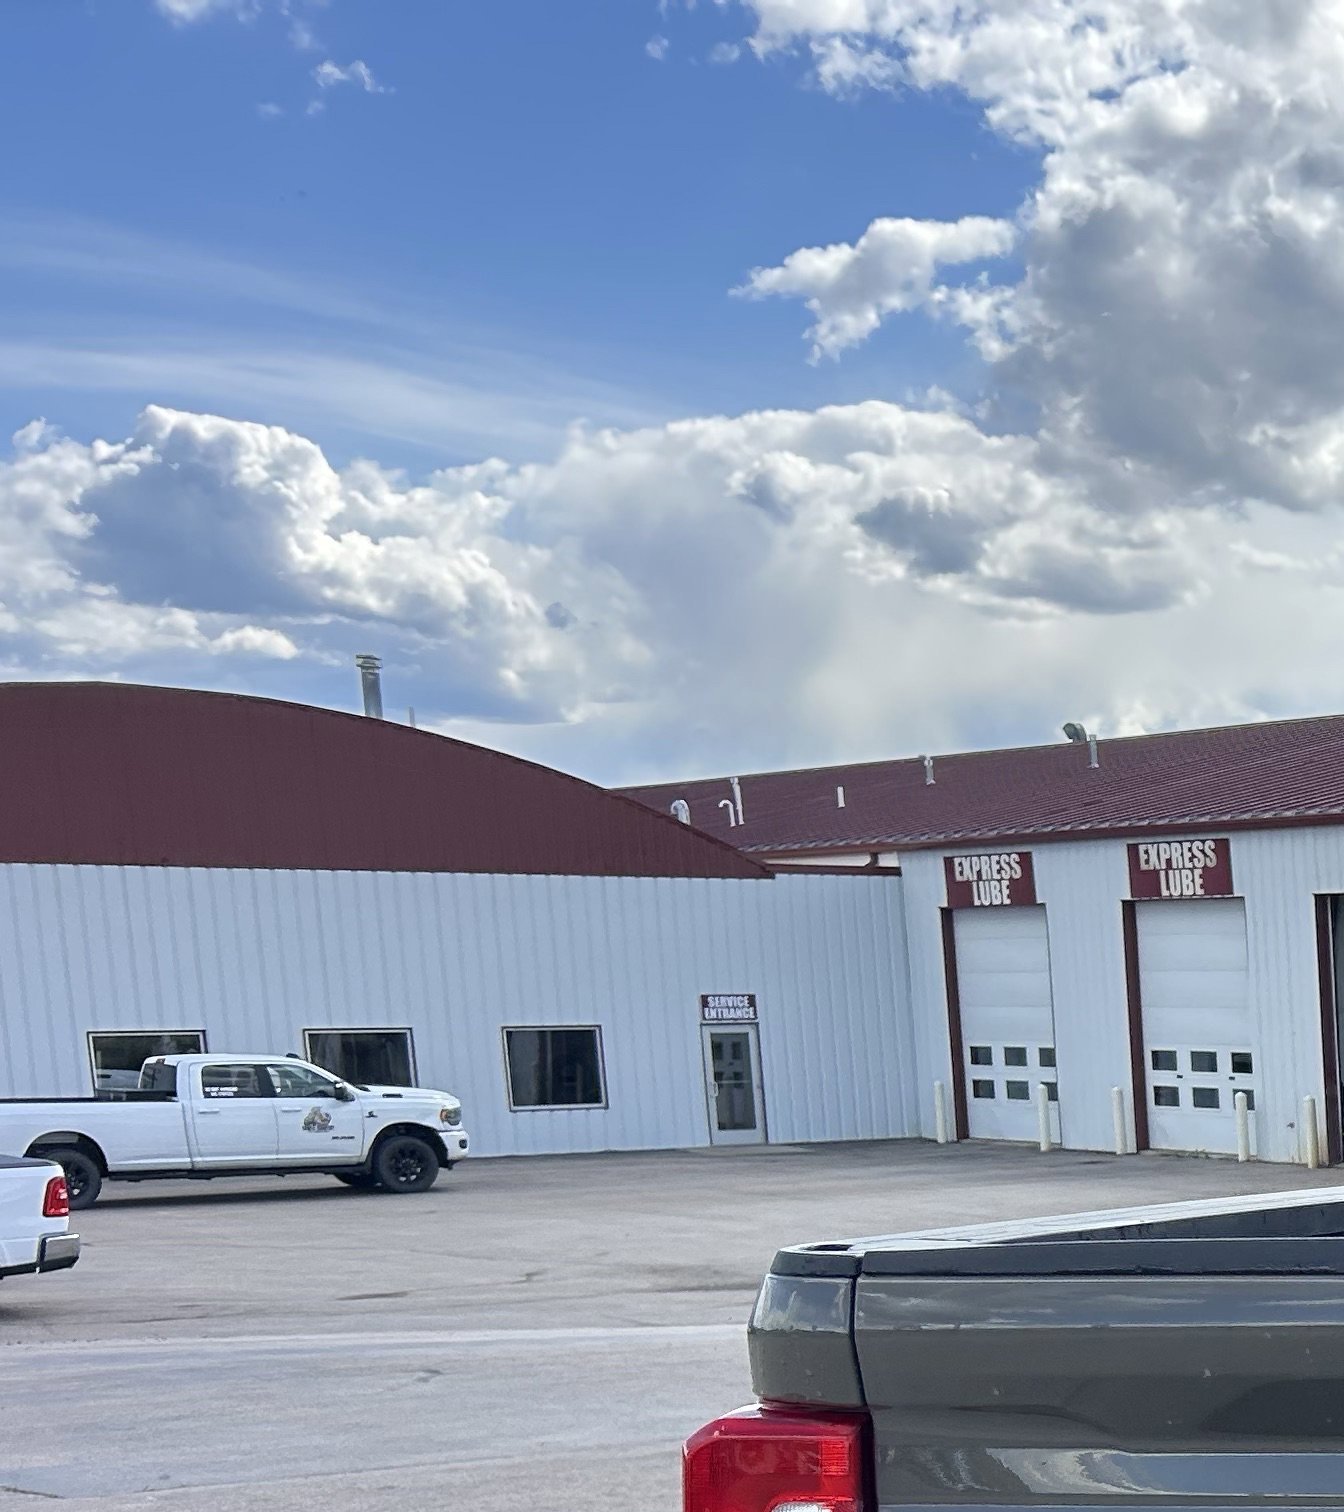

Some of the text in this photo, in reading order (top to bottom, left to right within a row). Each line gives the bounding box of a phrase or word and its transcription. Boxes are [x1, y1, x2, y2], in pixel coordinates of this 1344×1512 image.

[953, 853, 1022, 882] EXPRESS
[1138, 839, 1217, 871] EXPRESS
[972, 880, 1012, 906] LUBE
[1159, 868, 1205, 897] LUBE
[704, 1006, 755, 1019] ENTRANCE
[707, 995, 750, 1008] SERVICE
